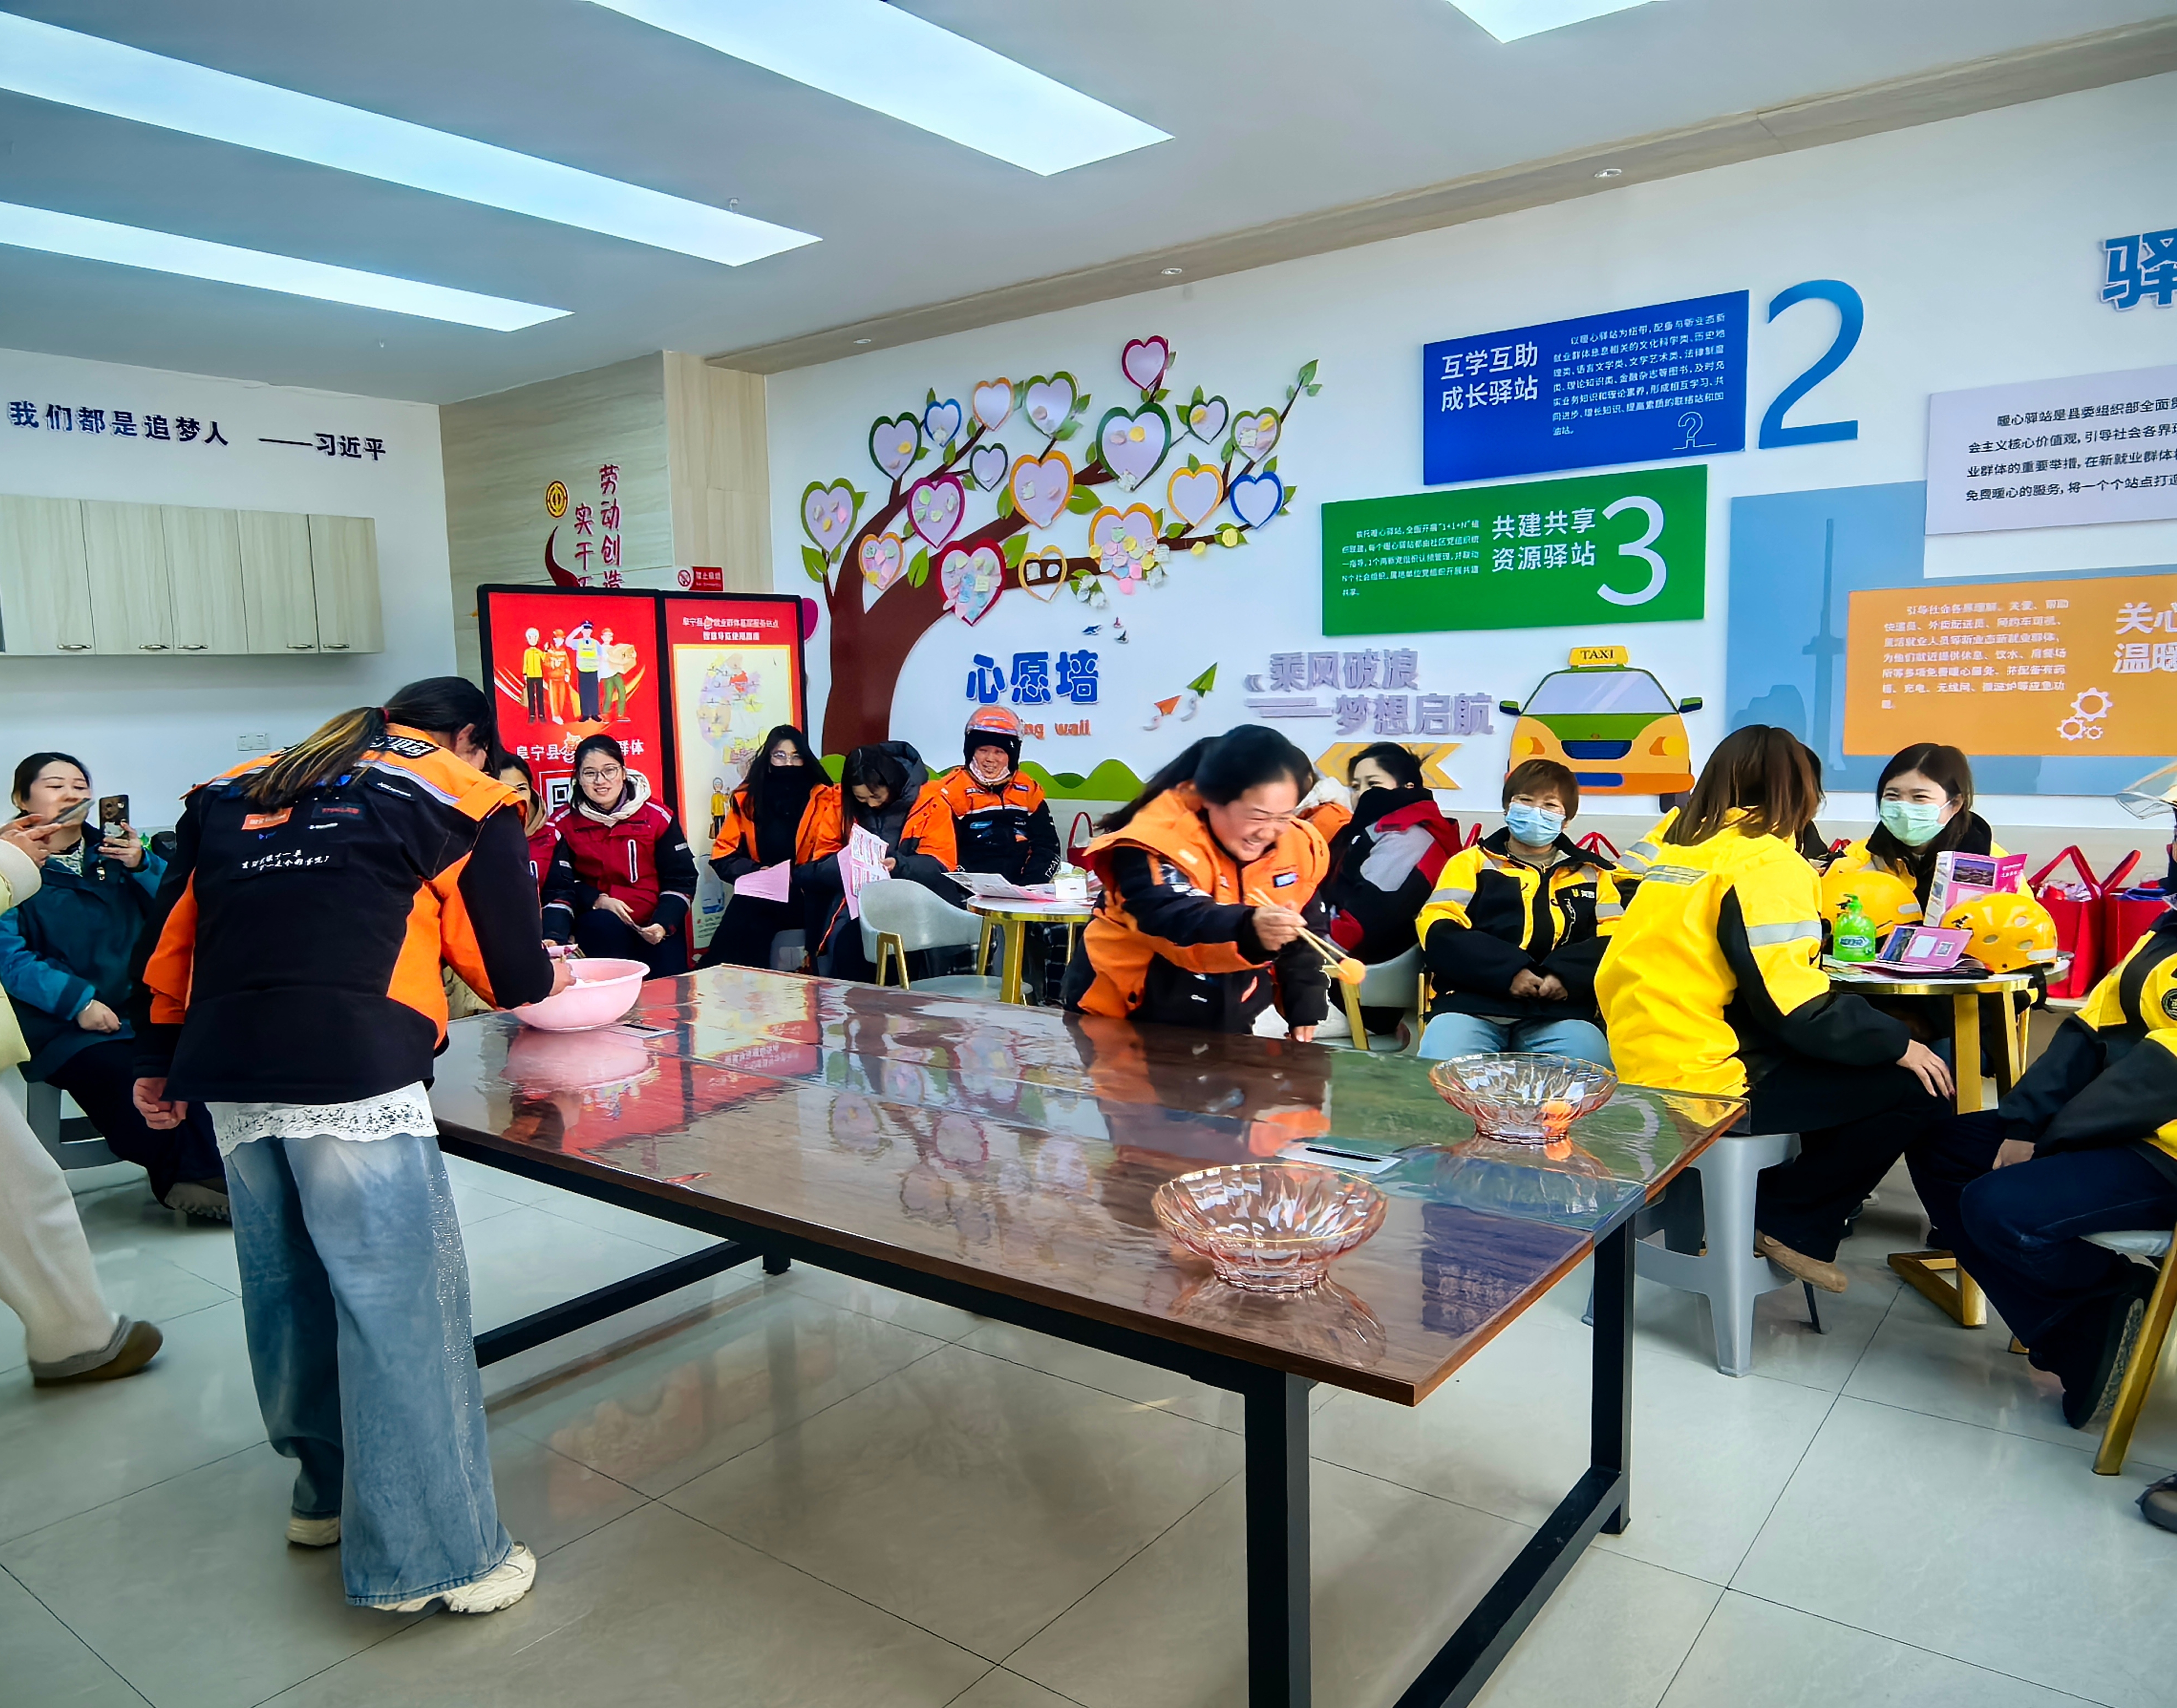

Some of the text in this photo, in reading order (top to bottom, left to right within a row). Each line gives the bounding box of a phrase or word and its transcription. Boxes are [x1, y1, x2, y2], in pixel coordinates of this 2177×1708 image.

[1441, 341, 1538, 381] 互学互助
[1759, 279, 1863, 449] 2
[1441, 376, 1538, 413] 成长驿站
[9, 400, 228, 445] 我们都是追梦人
[1967, 449, 2177, 478] 业群体的重要举措，在新就业群体
[599, 464, 624, 588] 劳动创造
[1492, 507, 1596, 540] 共建共享
[1492, 541, 1596, 573] 资源驿站
[1597, 495, 1667, 606] 3
[2115, 602, 2177, 634] 关心
[1269, 648, 1419, 692] 乘风破浪
[1581, 649, 1615, 660] TAXI
[965, 649, 1099, 705] 心愿墙
[1054, 718, 1091, 736] wall
[1335, 692, 1494, 735] 梦想启航
[516, 744, 560, 762] 阜宁县
